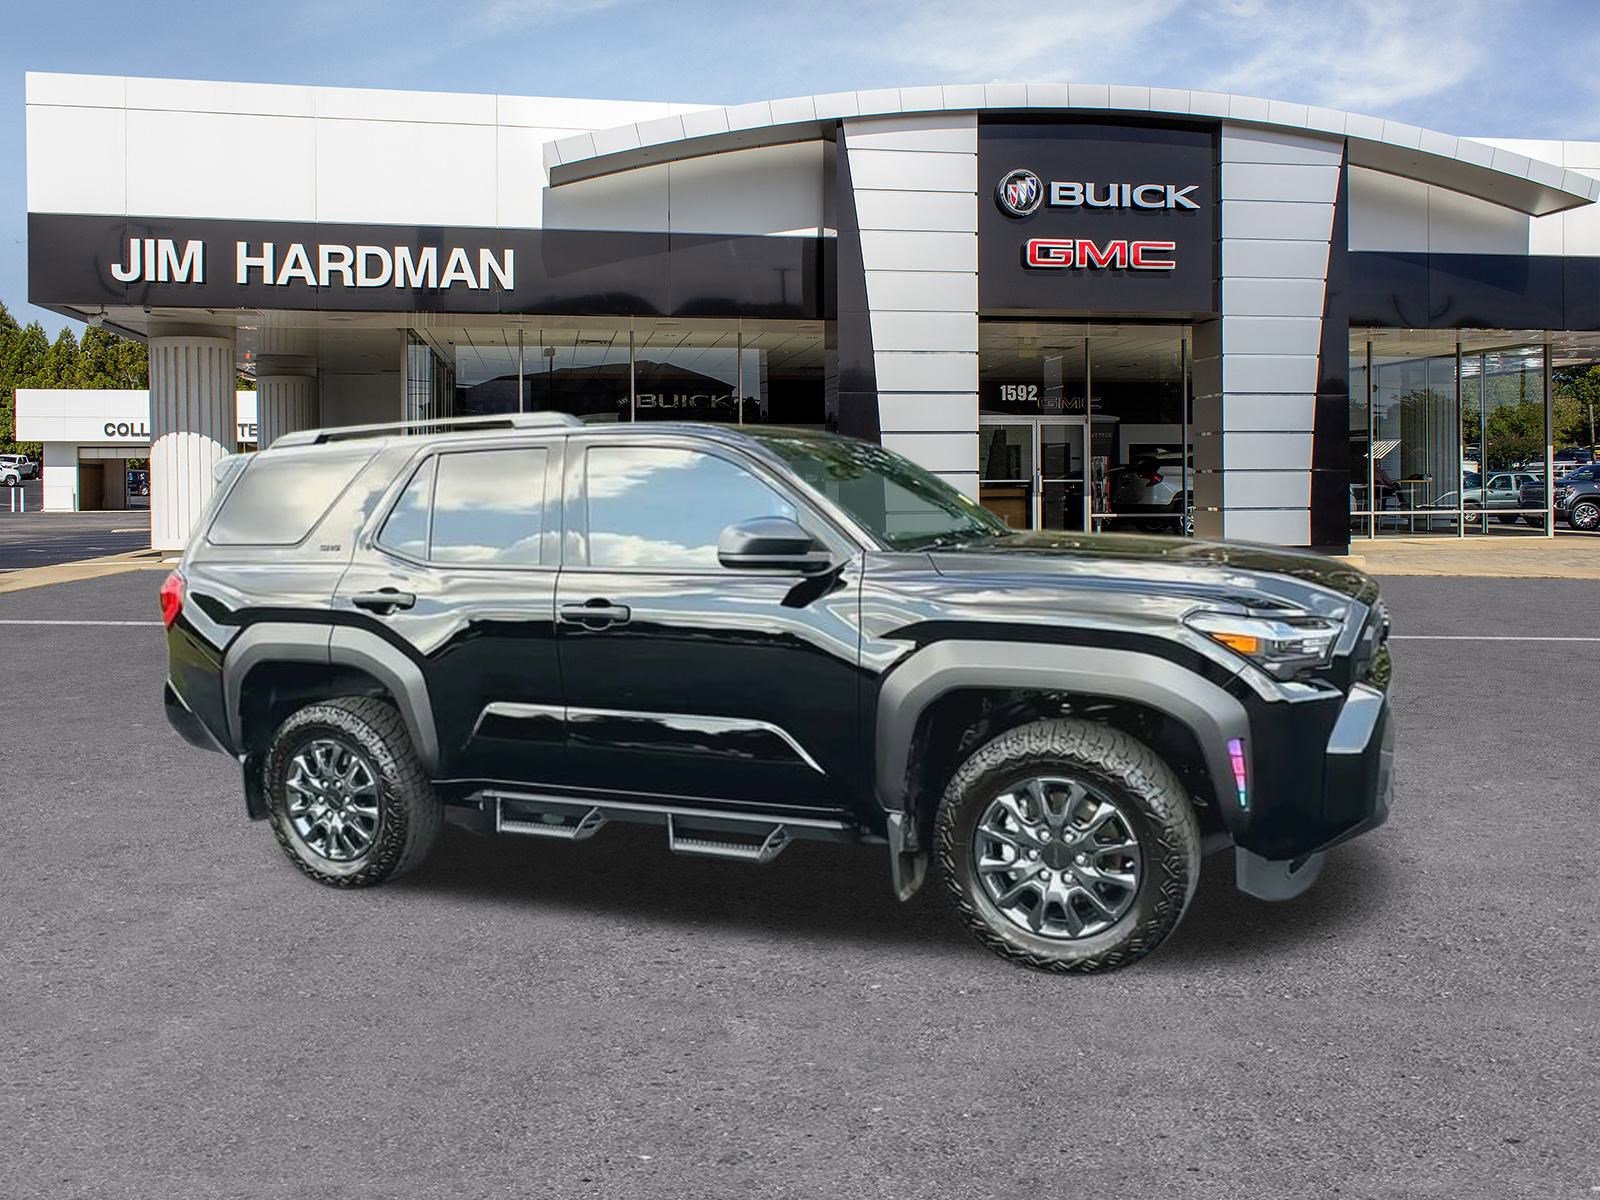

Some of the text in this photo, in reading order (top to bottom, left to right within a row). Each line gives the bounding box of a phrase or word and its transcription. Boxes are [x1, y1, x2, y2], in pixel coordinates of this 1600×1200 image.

[1050, 181, 1200, 209] BUICK
[1026, 238, 1176, 269] GMC
[111, 238, 514, 290] JIM HARDMAN
[636, 394, 732, 408] BUICK
[1000, 384, 1038, 401] 1592
[1037, 397, 1102, 409] GMC
[104, 422, 150, 437] COLL
